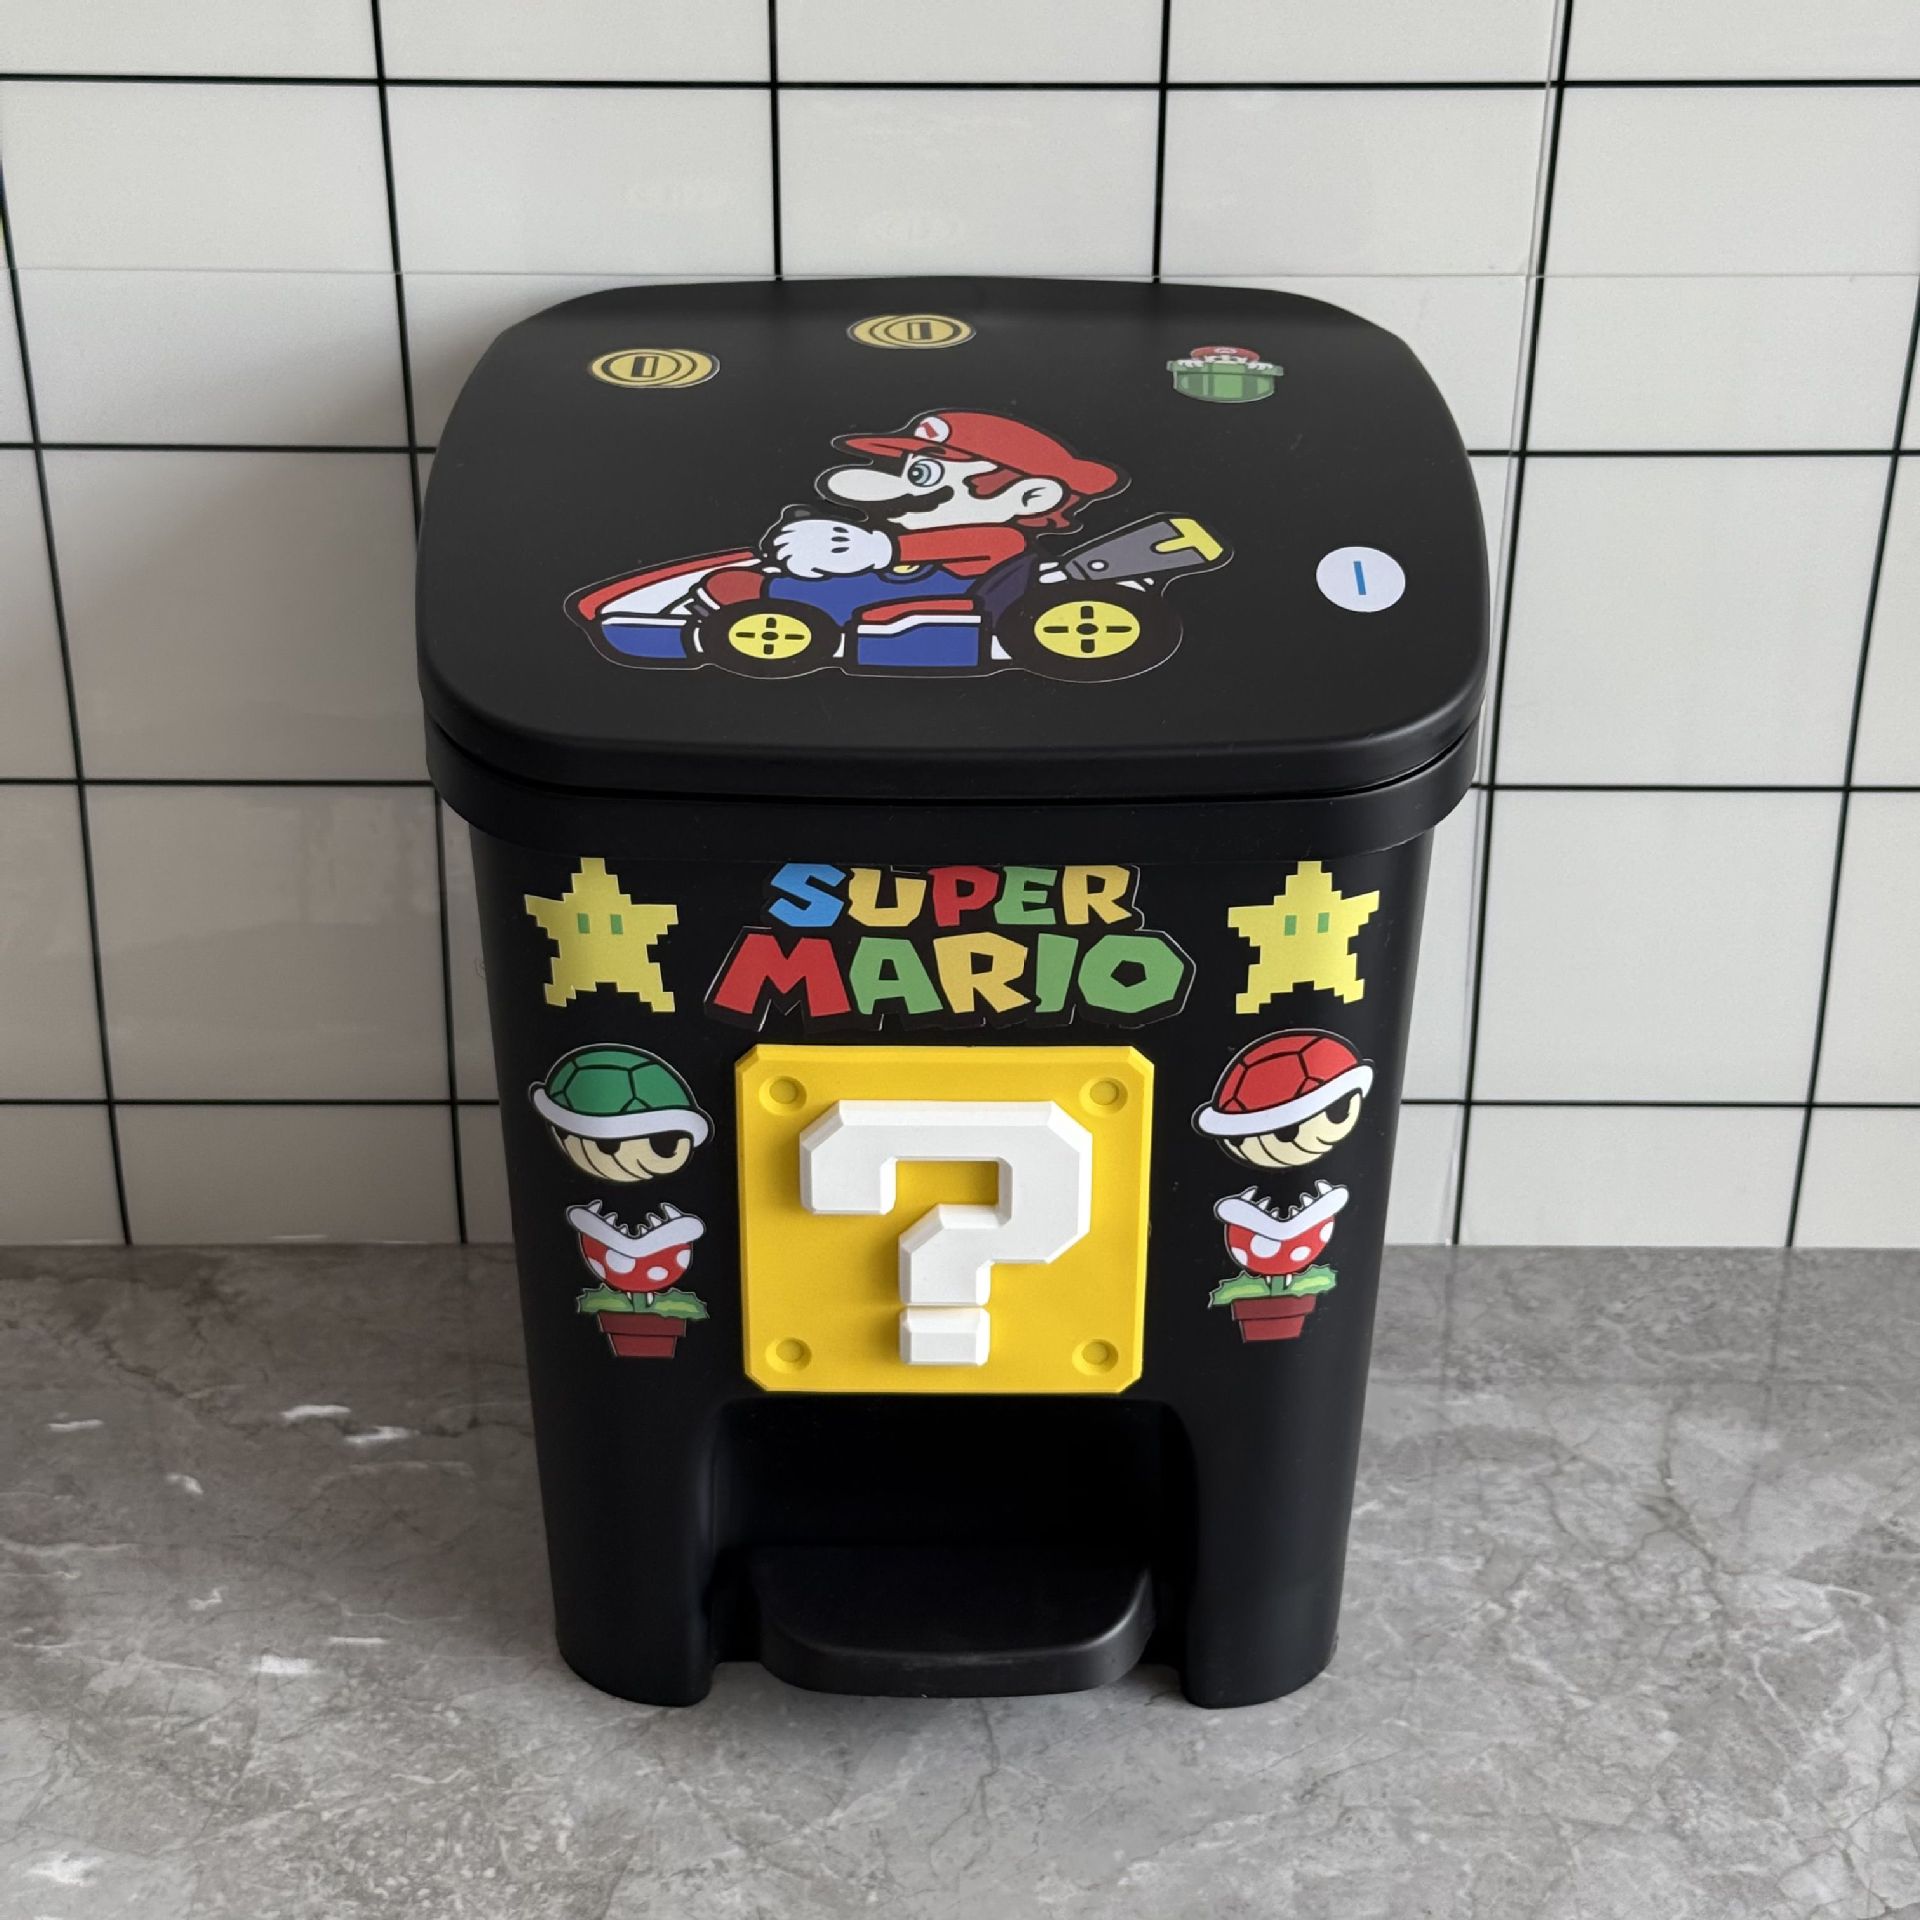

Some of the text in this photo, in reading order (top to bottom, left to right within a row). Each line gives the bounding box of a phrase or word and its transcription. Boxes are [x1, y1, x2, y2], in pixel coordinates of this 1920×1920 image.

[768, 863, 1132, 927] SUPER
[713, 932, 1185, 1017] MARIO
[800, 1100, 1092, 1366] ?
